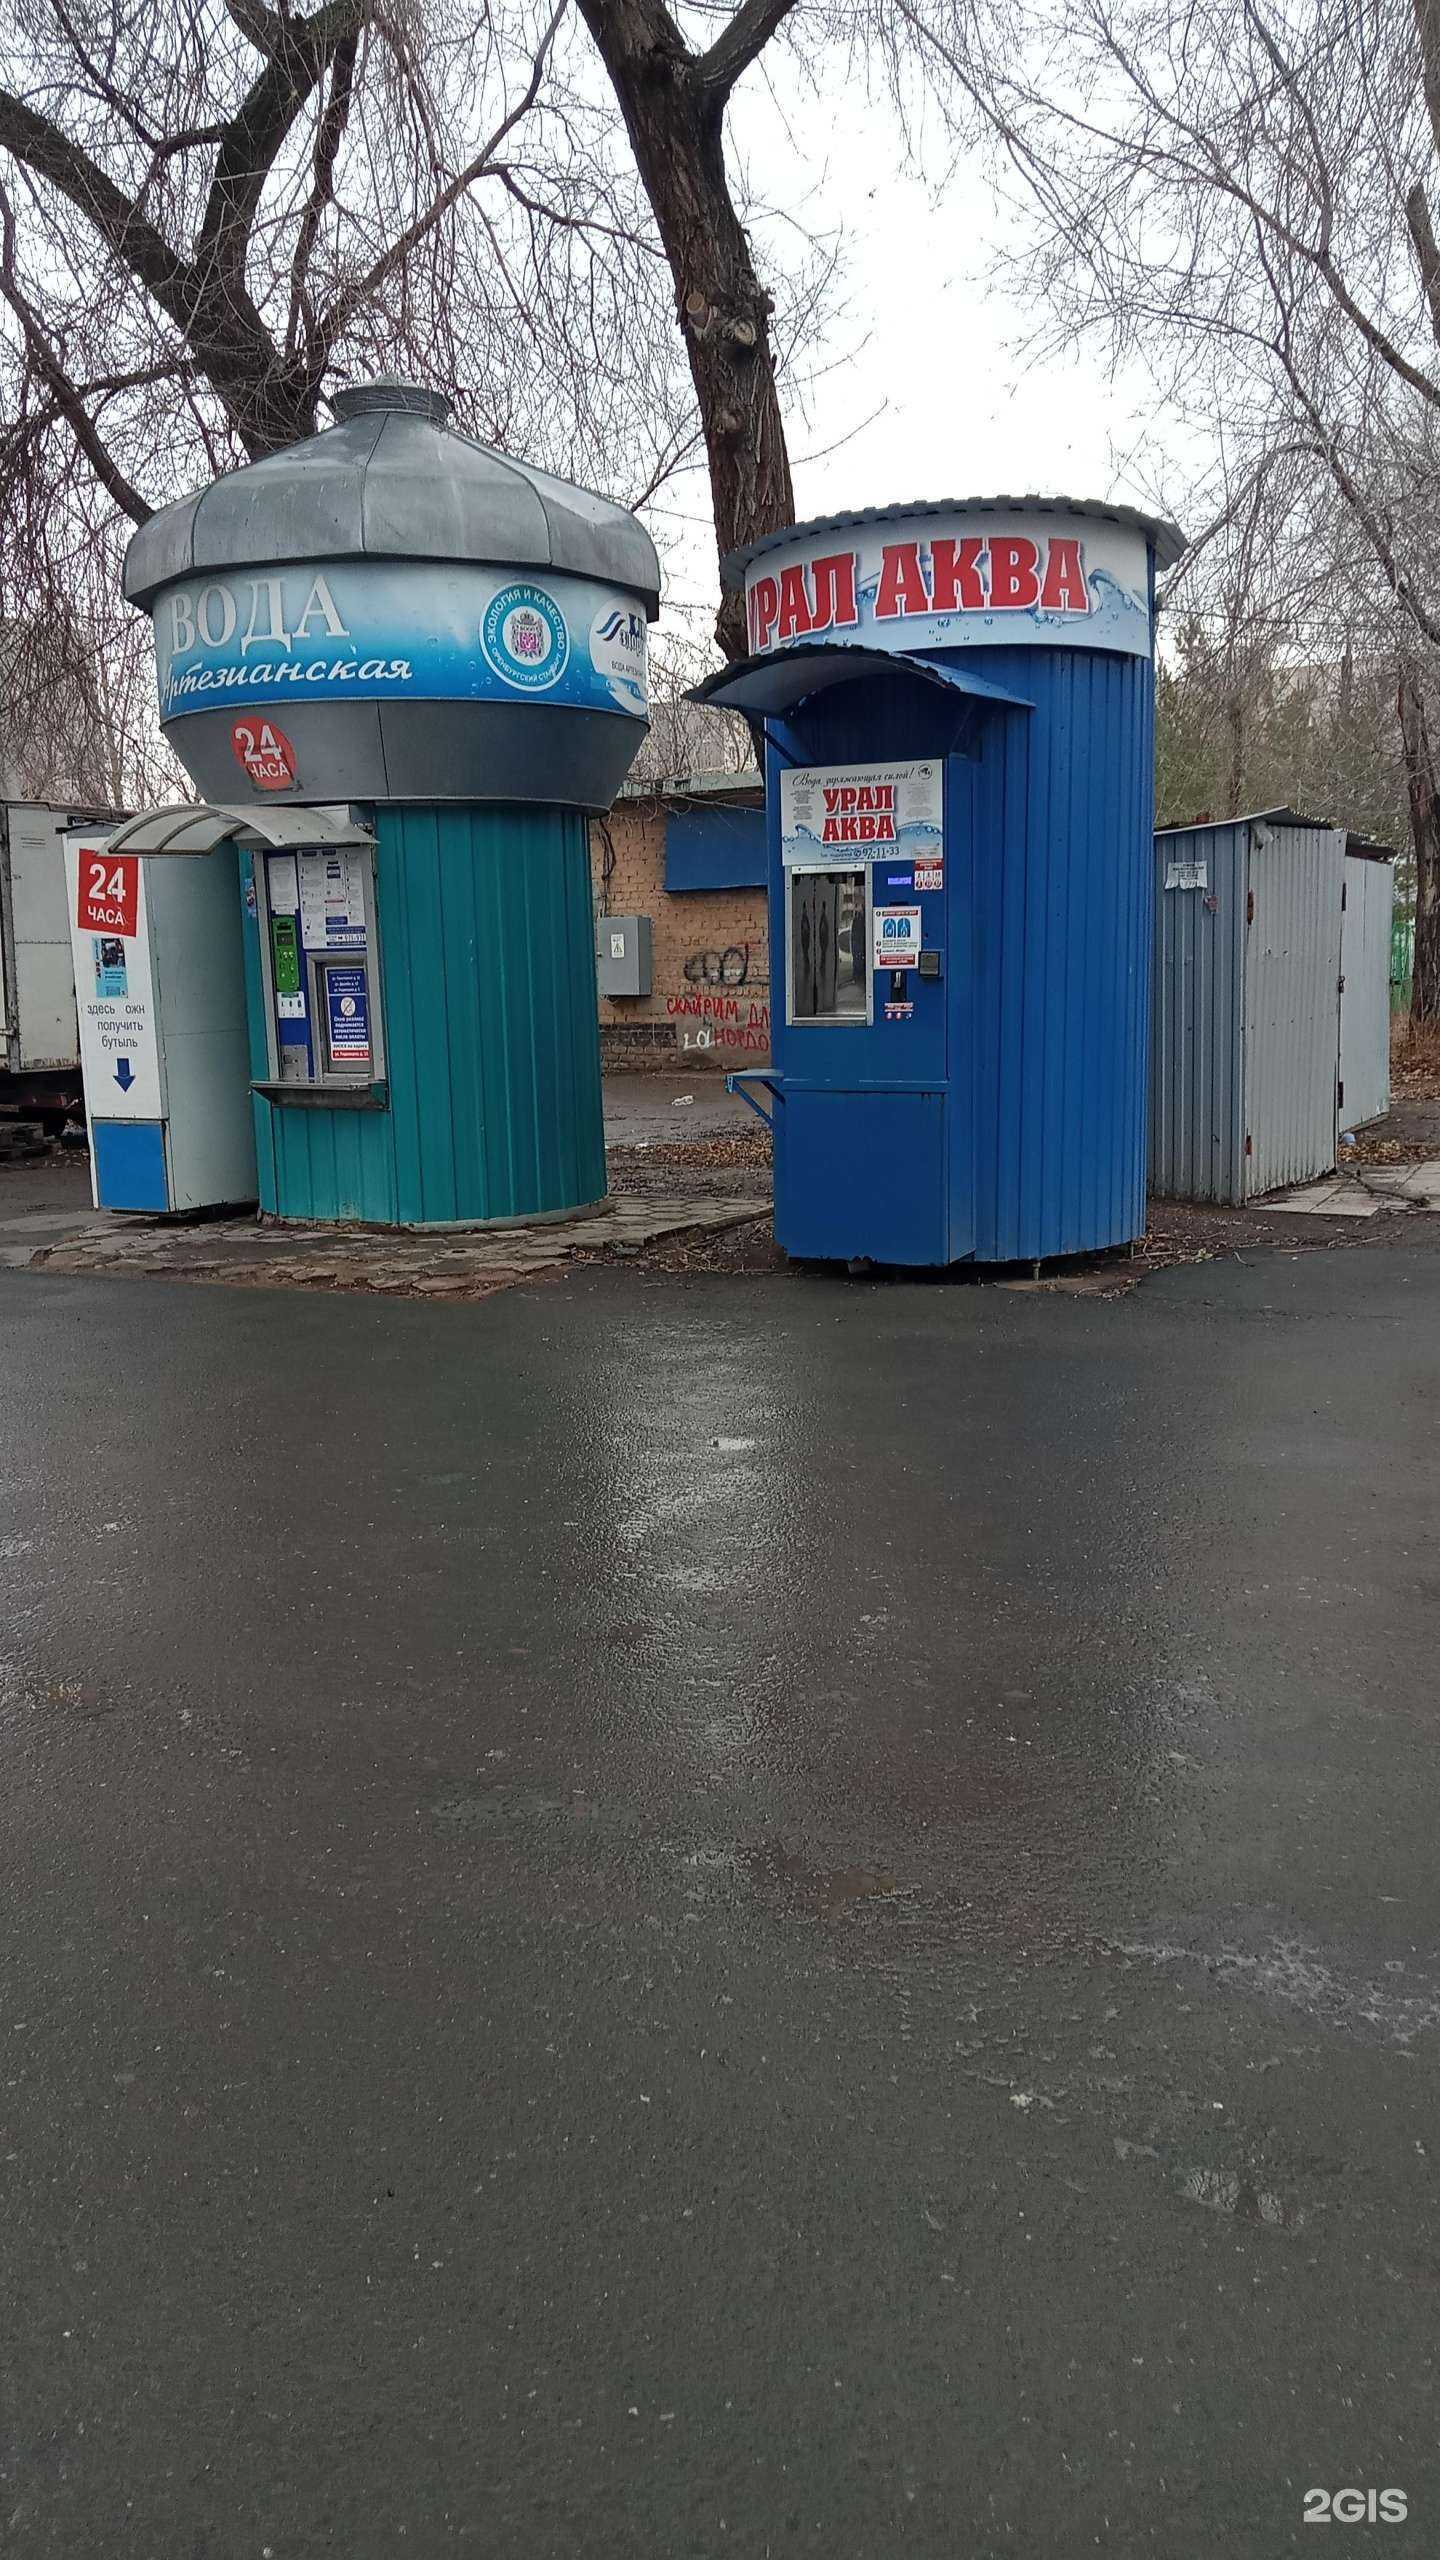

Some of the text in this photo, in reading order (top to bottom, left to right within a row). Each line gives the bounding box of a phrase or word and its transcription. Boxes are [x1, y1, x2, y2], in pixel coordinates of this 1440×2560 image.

[874, 537, 1090, 620] АКВА
[171, 575, 351, 656] ВОДА
[488, 588, 565, 650] ЭКОЛОГИЯ И КАЧЕСТВО
[161, 645, 412, 711] Артезианская
[235, 725, 283, 761] 24
[250, 761, 290, 778] ЧАСА
[822, 784, 895, 814] УРАЛ
[822, 814, 897, 843] АКВА
[88, 863, 127, 903] 24
[87, 905, 125, 926] ЧАСА
[87, 1004, 116, 1016] здесь
[666, 992, 739, 1022] СКАЙРИМ
[97, 1021, 144, 1034] получить
[101, 1035, 138, 1050] бутыль
[683, 1029, 713, 1051] LOL
